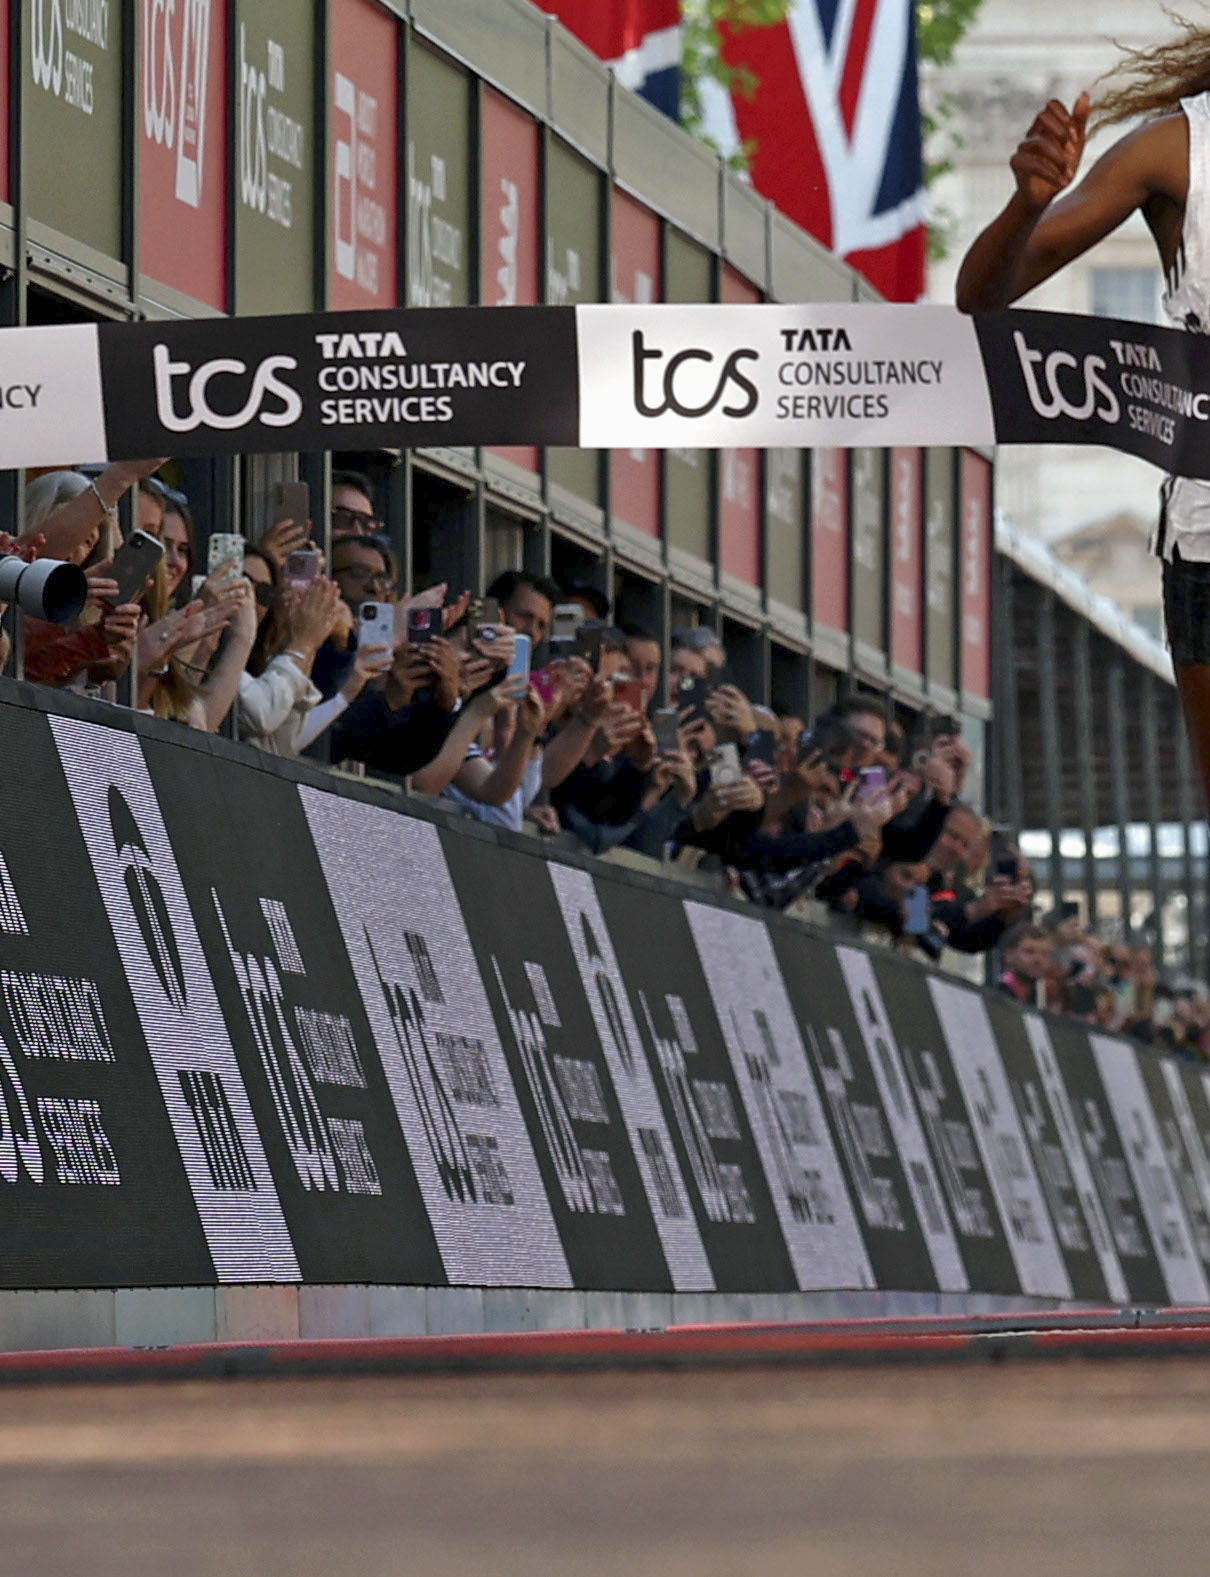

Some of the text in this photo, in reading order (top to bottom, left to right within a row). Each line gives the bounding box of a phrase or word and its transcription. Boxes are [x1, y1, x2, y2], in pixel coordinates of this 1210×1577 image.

[315, 331, 407, 359] TATA
[780, 327, 853, 352] TATA
[1109, 339, 1163, 373] TATA
[153, 343, 303, 432] tcs
[318, 361, 526, 392] CONSULTANCY
[631, 329, 760, 419] tcs
[778, 359, 944, 386] CONSULTANCY
[1013, 330, 1120, 424] tcs
[320, 395, 454, 425] SERVICES
[776, 394, 890, 420] SERVICES
[1127, 404, 1176, 446] SERVICES
